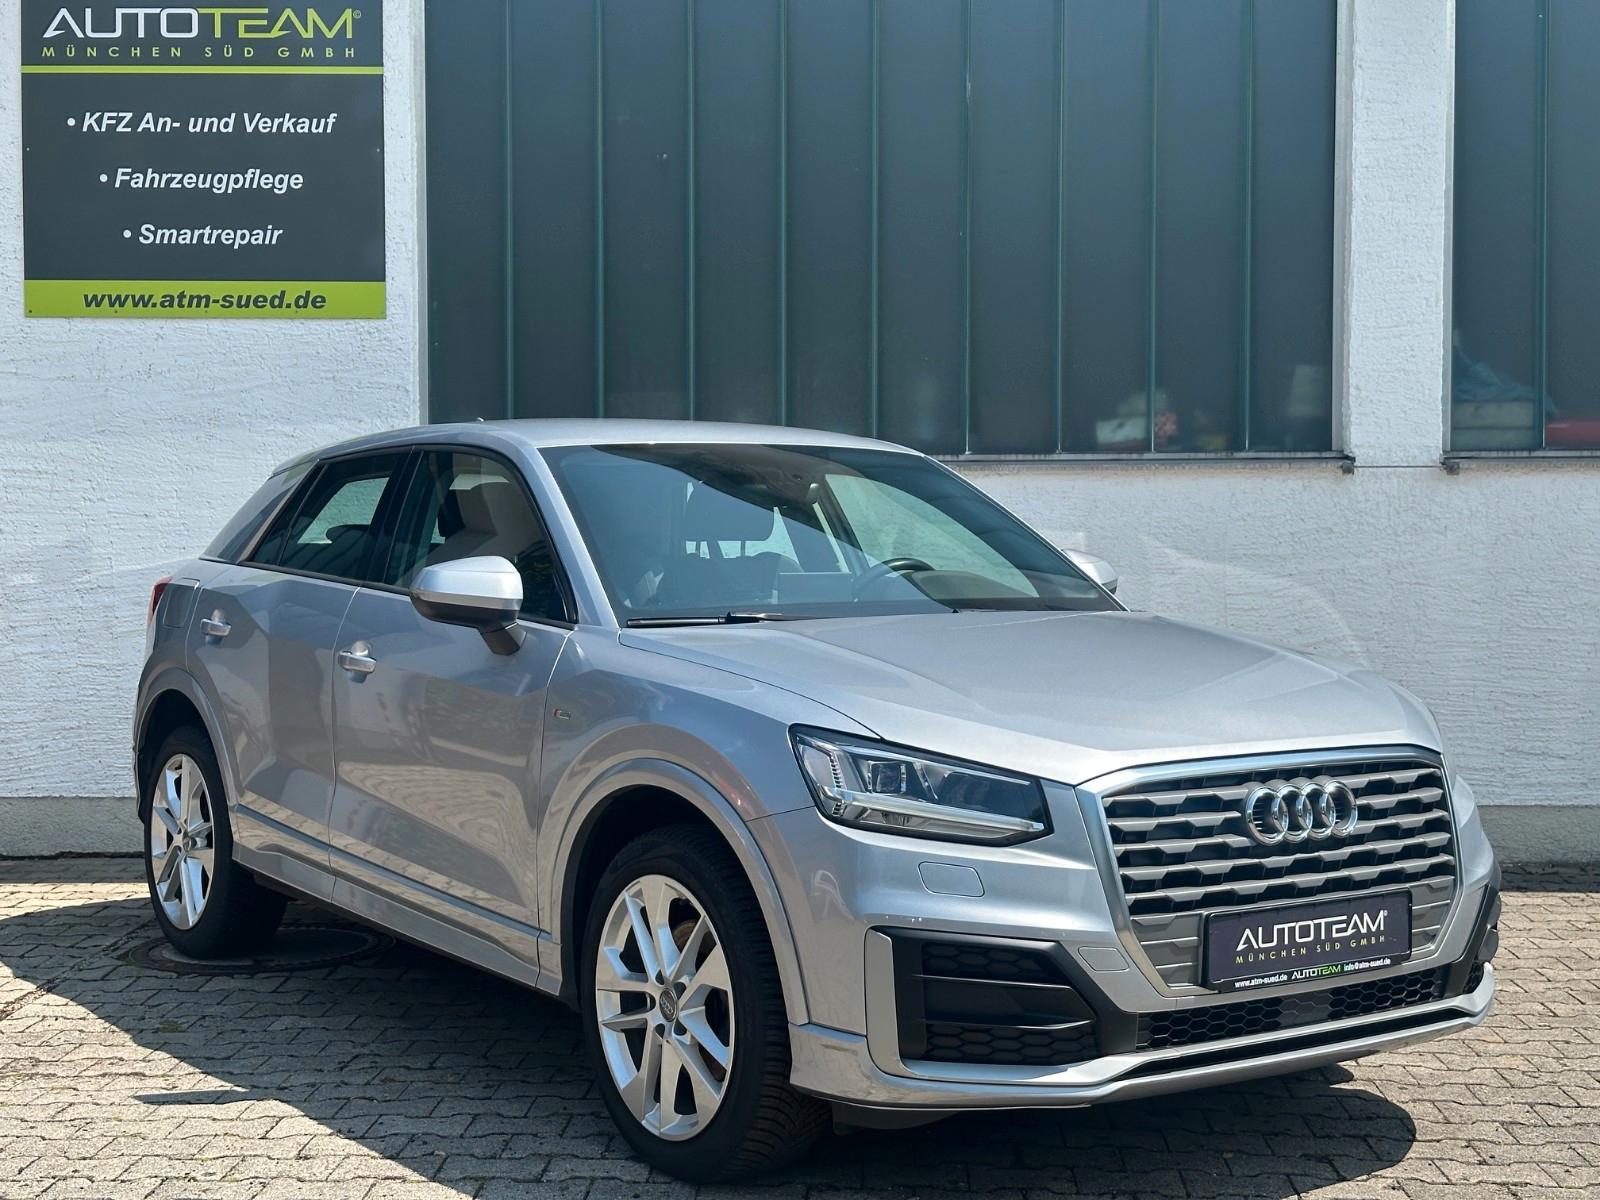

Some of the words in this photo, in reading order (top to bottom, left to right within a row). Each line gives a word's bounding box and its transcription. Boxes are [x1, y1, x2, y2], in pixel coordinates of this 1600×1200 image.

[41, 44, 182, 58] MÜNCHEN
[204, 44, 255, 58] SÜD
[277, 46, 355, 58] GMBH
[82, 112, 133, 133] KFZ
[137, 112, 181, 133] An-
[188, 112, 236, 134] und
[243, 112, 338, 134] Verkauf
[114, 167, 304, 194] Fahrzeugpflege
[138, 224, 284, 249] Smartrepair
[82, 289, 327, 310] www.atm-sued.de
[1235, 947, 1307, 964] MÜNCHEN
[1316, 941, 1341, 953] SÜD
[1350, 935, 1385, 948] GMBH
[1291, 965, 1341, 979] AUTOTEAM
